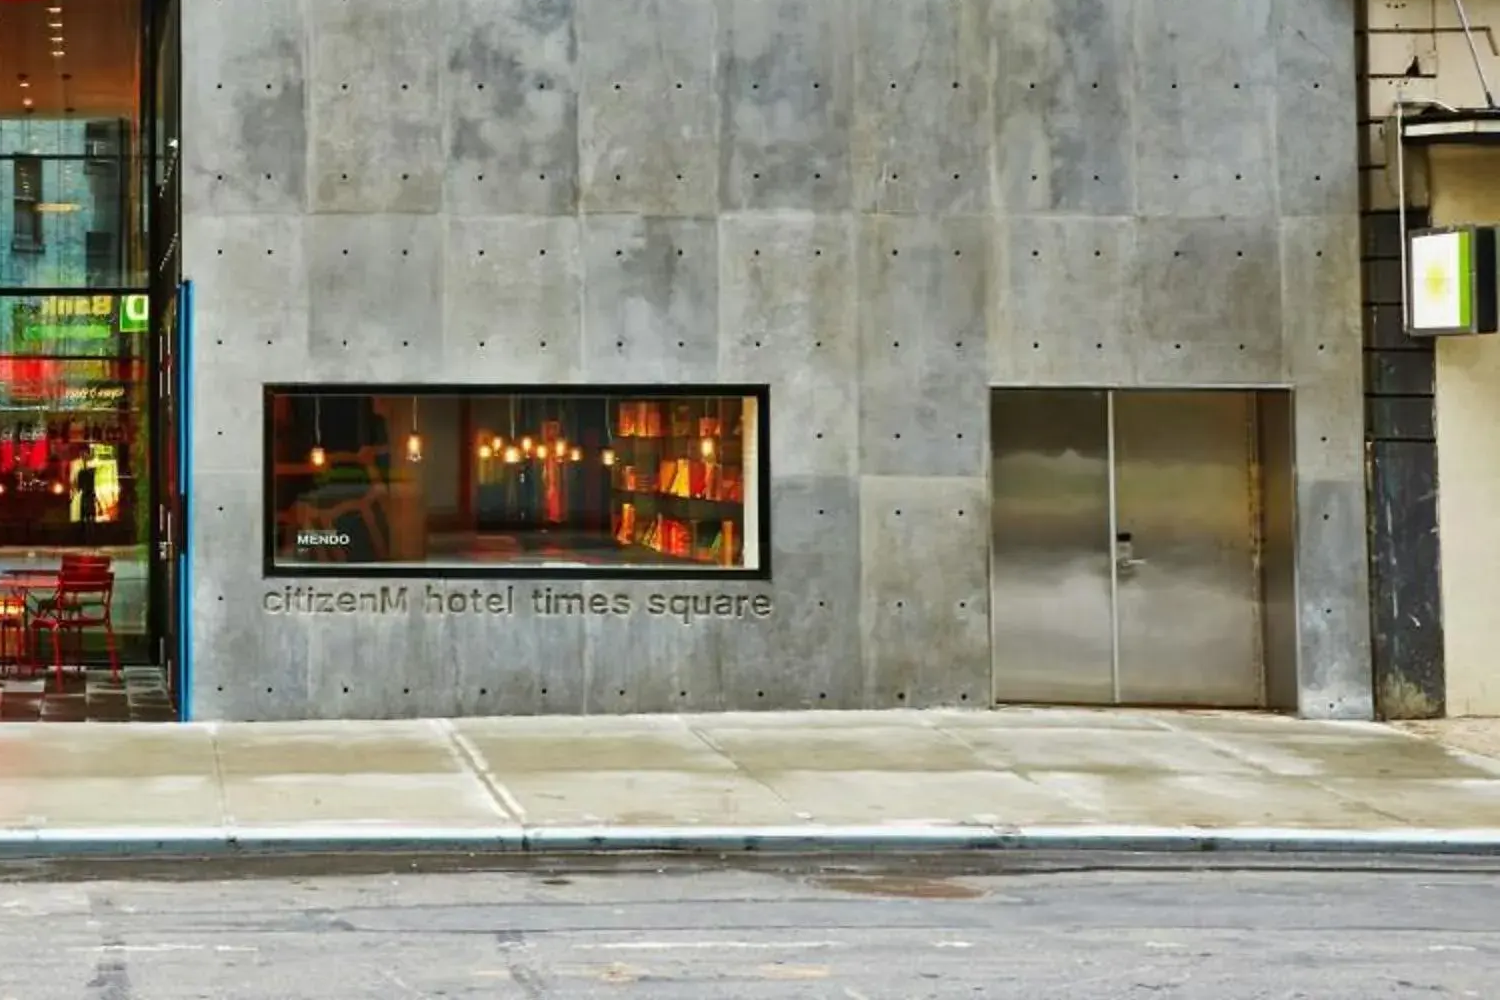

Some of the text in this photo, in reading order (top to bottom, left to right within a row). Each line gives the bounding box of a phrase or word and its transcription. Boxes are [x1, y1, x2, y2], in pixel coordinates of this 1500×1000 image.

[297, 534, 350, 545] MENDO
[263, 585, 773, 626] citizenM hotel times square
